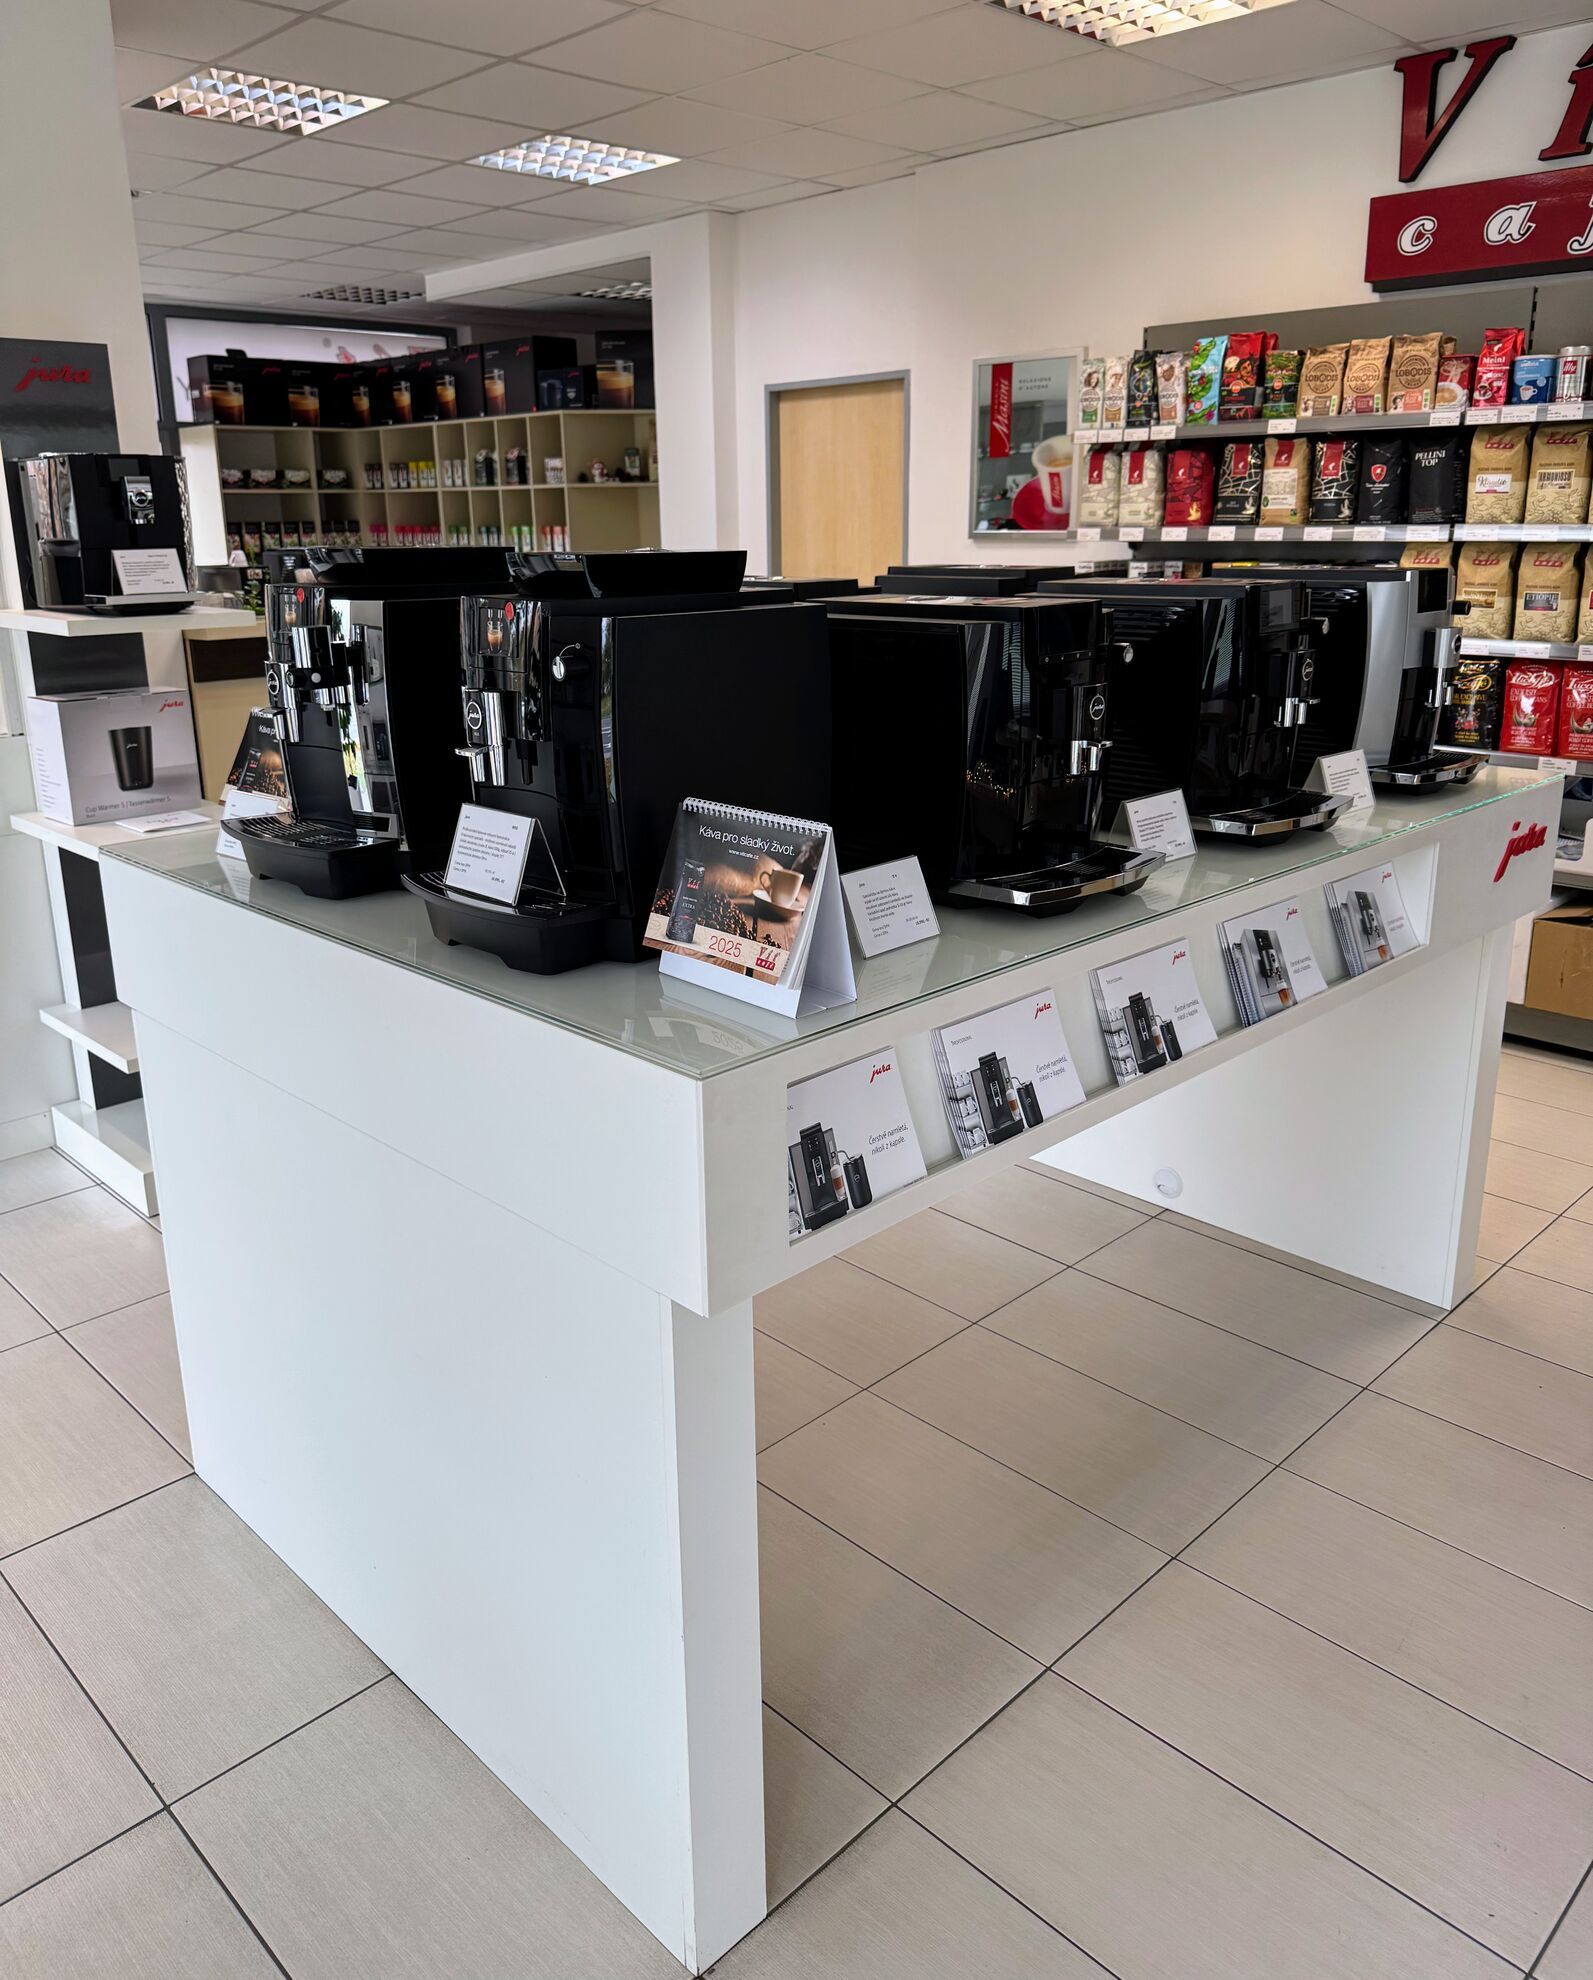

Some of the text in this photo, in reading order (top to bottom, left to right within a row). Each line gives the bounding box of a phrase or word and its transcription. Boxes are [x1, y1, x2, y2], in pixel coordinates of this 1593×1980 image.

[1482, 356, 1505, 364] Meinl
[1395, 367, 1432, 378] LOBODIS
[1563, 362, 1576, 372] illy
[15, 356, 92, 393] jura
[1305, 373, 1338, 383] LOBODIS
[1346, 373, 1380, 383] LOBODIS
[1415, 450, 1446, 461] PELLINI
[1421, 458, 1439, 467] TOP
[159, 699, 184, 712] jura
[699, 825, 795, 856] Káva pro sladký život.
[1493, 821, 1548, 883] jura
[709, 935, 743, 958] 2025
[1034, 1002, 1052, 1020] jura
[869, 1063, 892, 1084] jura
[868, 1130, 887, 1145] Čerstvě
